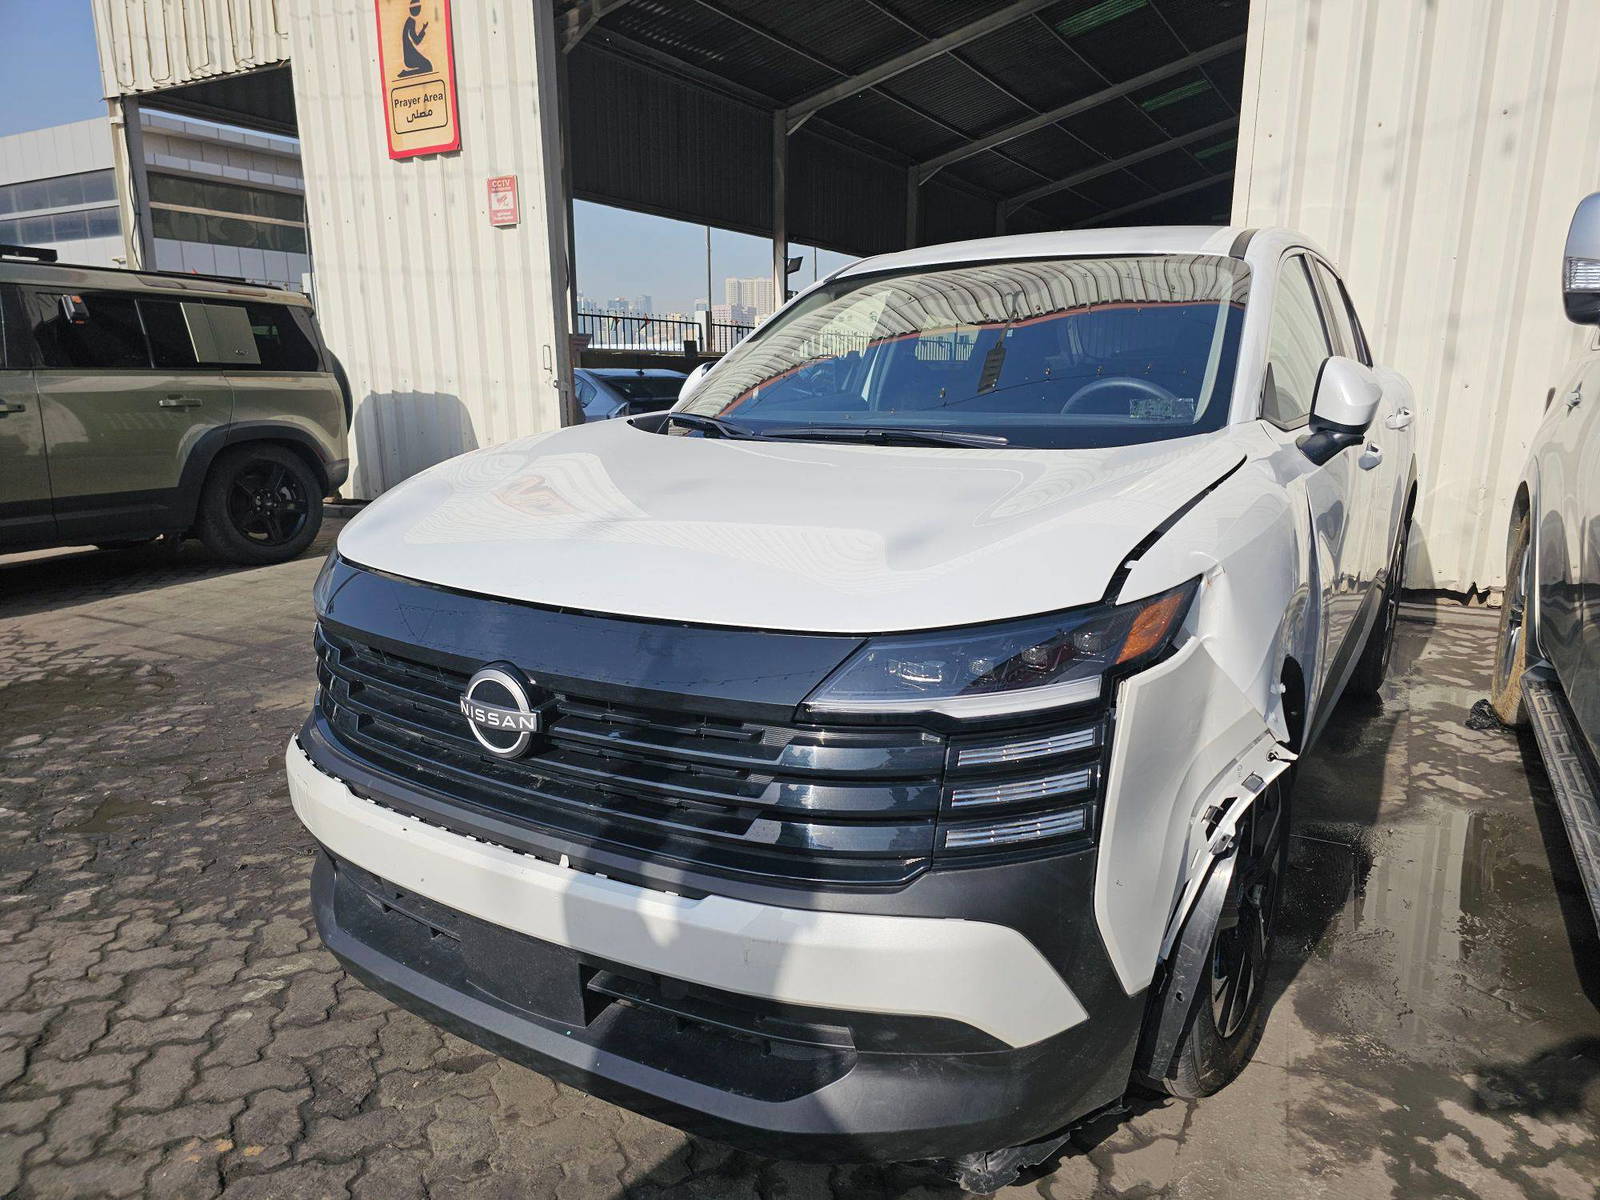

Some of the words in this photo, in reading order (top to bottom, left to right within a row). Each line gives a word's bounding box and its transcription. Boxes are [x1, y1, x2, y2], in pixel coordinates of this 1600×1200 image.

[394, 97, 420, 108] Prayer
[423, 93, 443, 103] Area
[406, 109, 433, 123] مصلى
[460, 700, 534, 729] NISSAN
